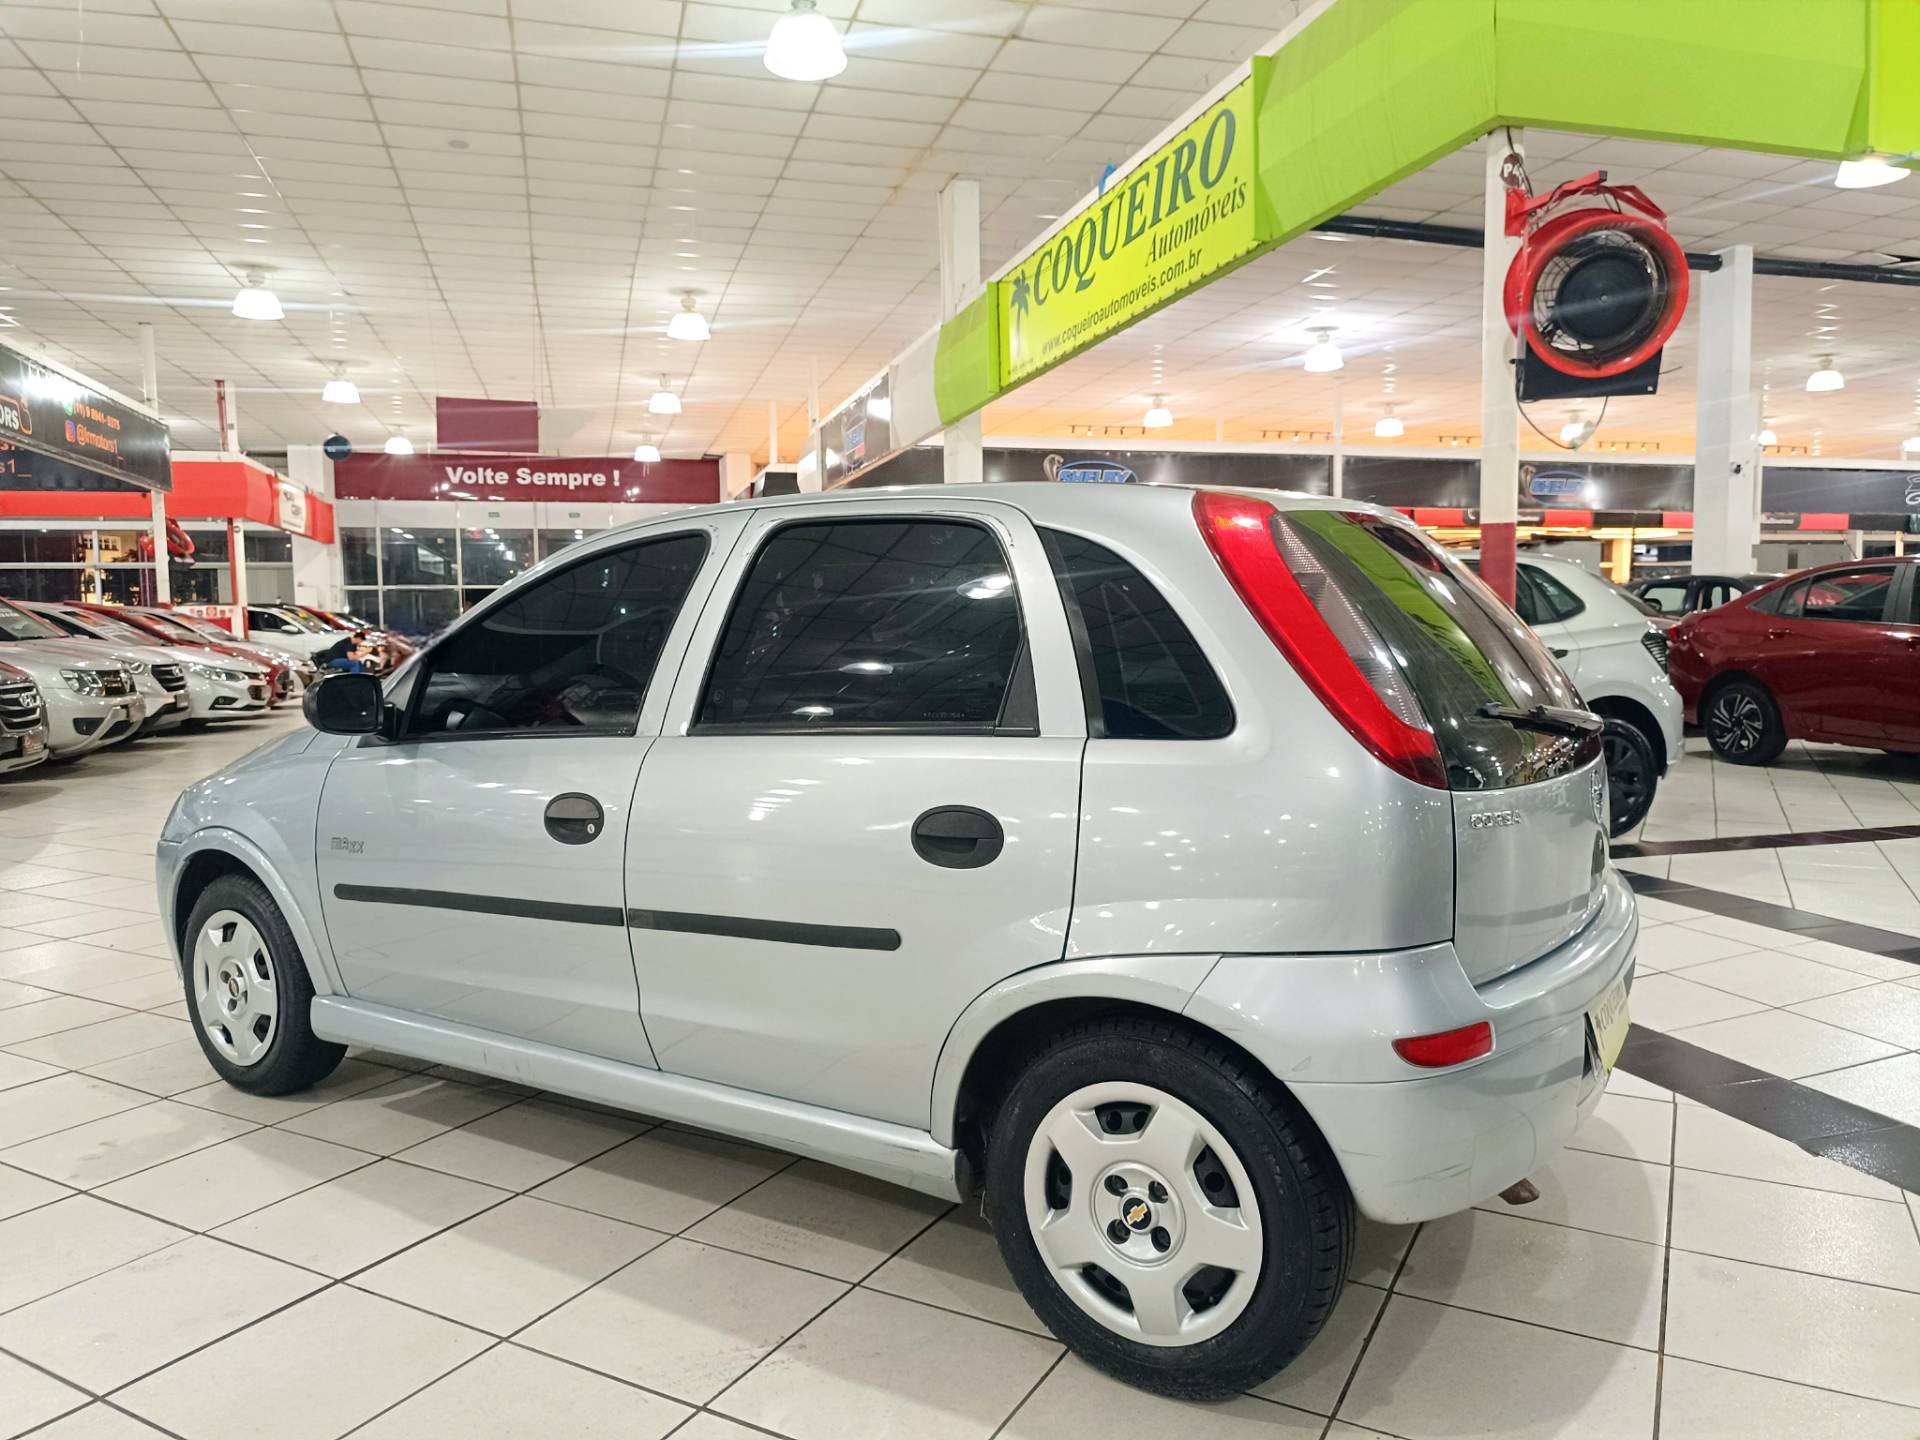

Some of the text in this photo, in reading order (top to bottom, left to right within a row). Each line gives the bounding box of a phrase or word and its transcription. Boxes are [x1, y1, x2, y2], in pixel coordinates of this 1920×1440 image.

[1033, 108, 1236, 306] COQUEIRO
[1145, 176, 1247, 267] Automóveis
[1042, 248, 1203, 354] www.coqueiroautomoveis.com.br
[445, 466, 509, 485] Volte
[516, 467, 607, 490] Sempre
[1470, 810, 1522, 829] CORSA
